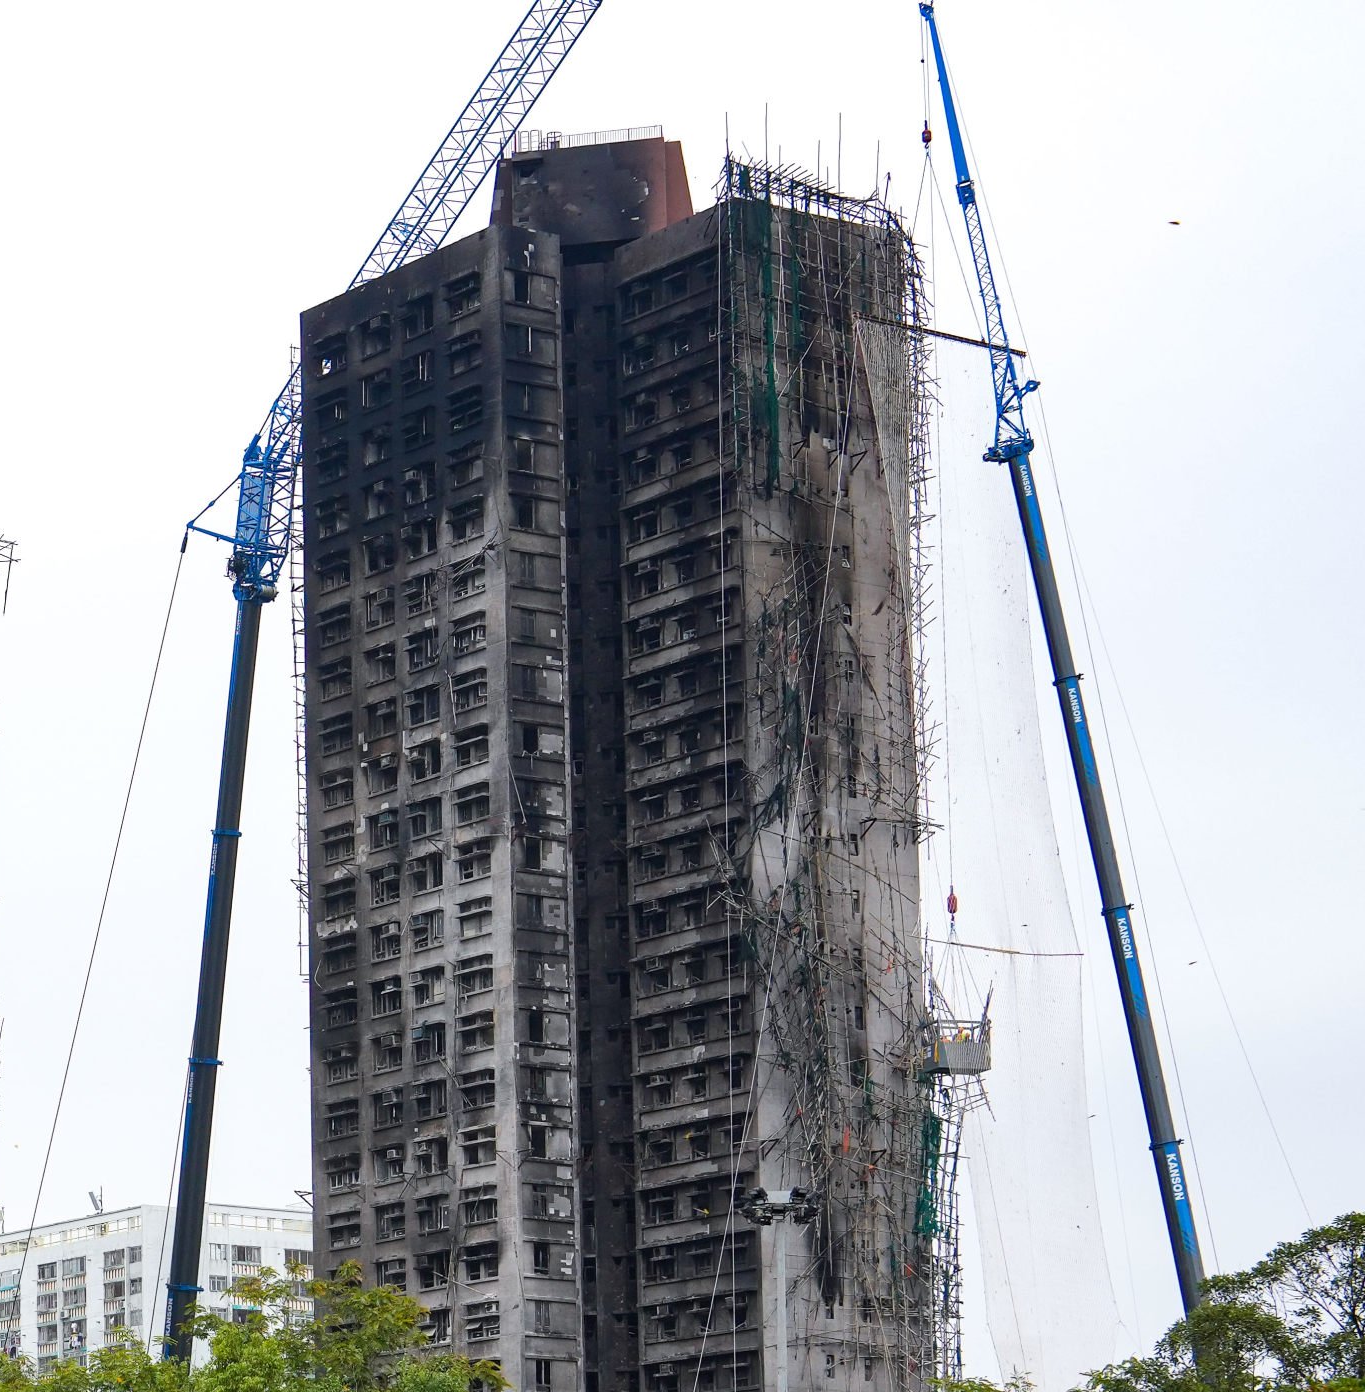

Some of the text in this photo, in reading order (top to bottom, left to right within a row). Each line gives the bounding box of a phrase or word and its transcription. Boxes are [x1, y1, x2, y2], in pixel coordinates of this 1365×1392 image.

[1019, 464, 1033, 497] KANSON
[1068, 687, 1082, 723] KANSON
[1117, 917, 1133, 959] KANSON
[1166, 1153, 1185, 1201] KANSON
[165, 1297, 174, 1337] KANSON
